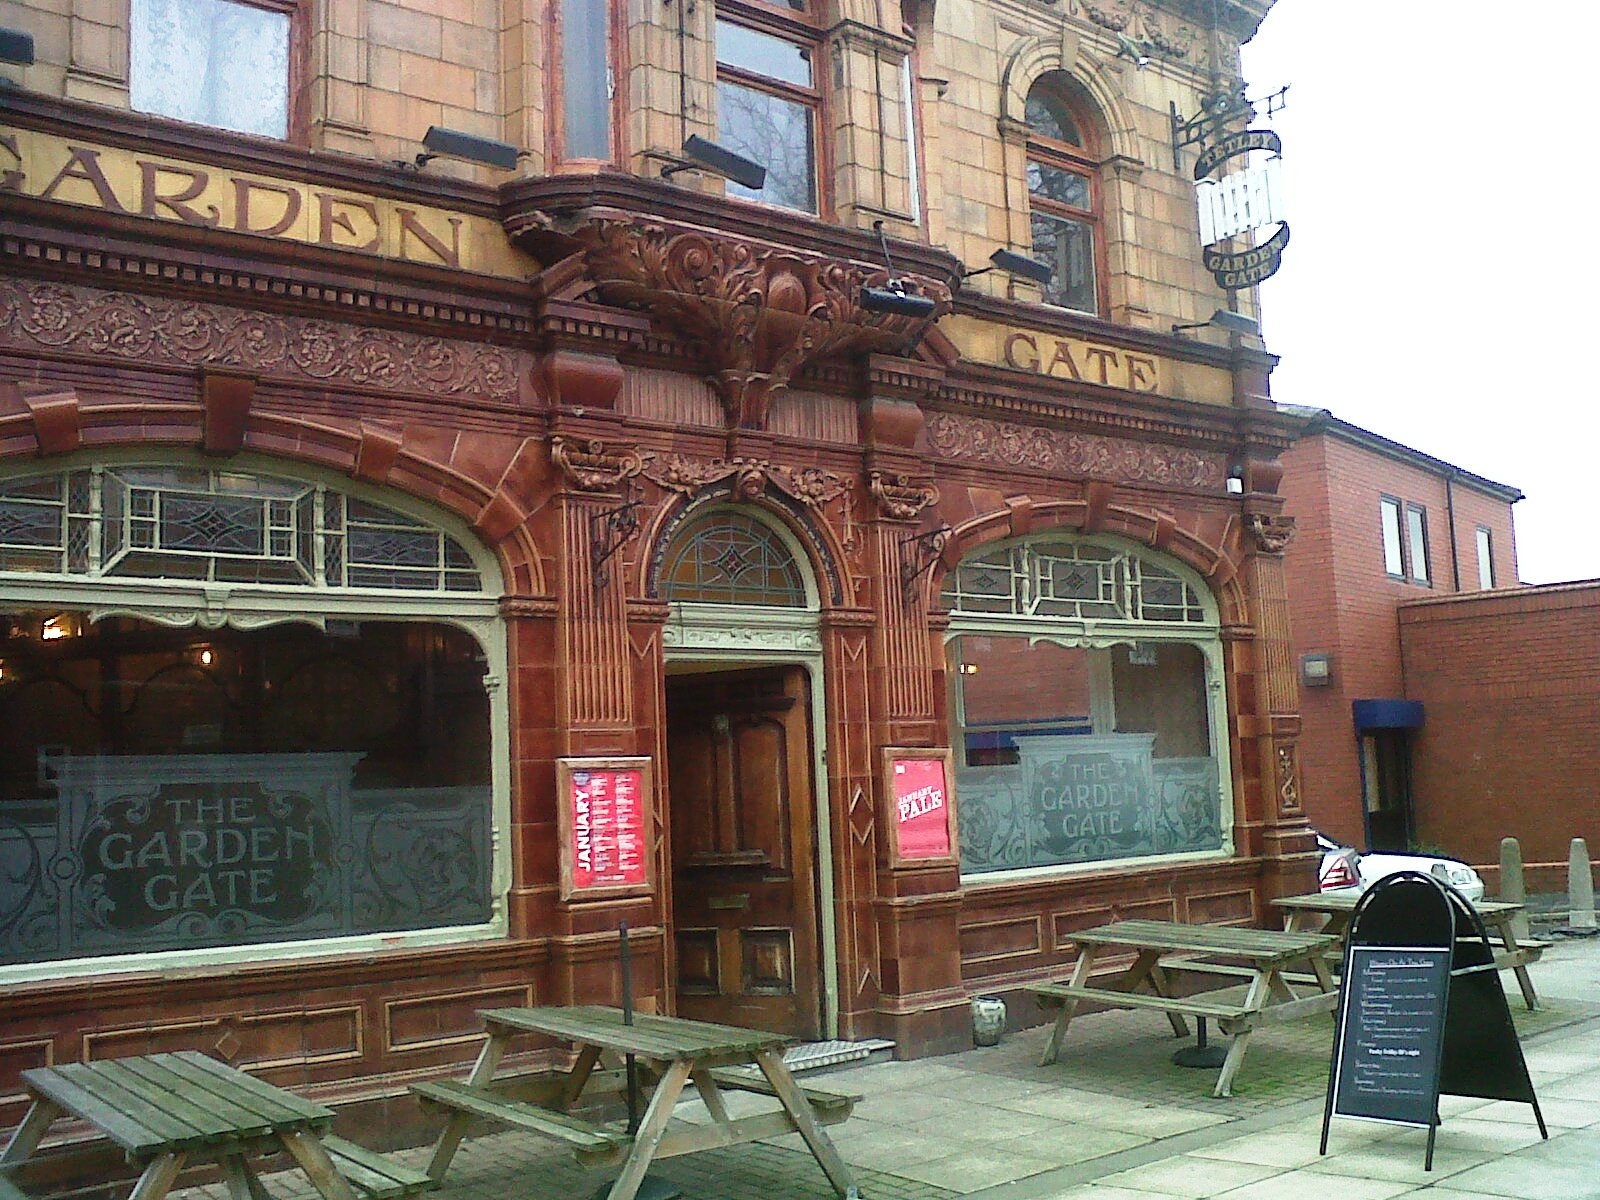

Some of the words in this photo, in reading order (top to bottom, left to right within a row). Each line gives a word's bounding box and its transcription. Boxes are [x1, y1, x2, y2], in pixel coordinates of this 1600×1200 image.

[1204, 133, 1273, 166] TETLEY
[1209, 237, 1283, 271] GARDEN
[1225, 263, 1270, 287] GATE
[1003, 332, 1159, 394] GATE
[1070, 763, 1112, 781] THE
[166, 797, 257, 825] THE
[898, 790, 943, 823] PALE
[1041, 783, 1139, 811] GARDEN
[575, 789, 592, 873] JANUARY
[1063, 811, 1123, 839] GATE
[99, 826, 315, 871] GARDEN
[144, 869, 279, 912] GATE
